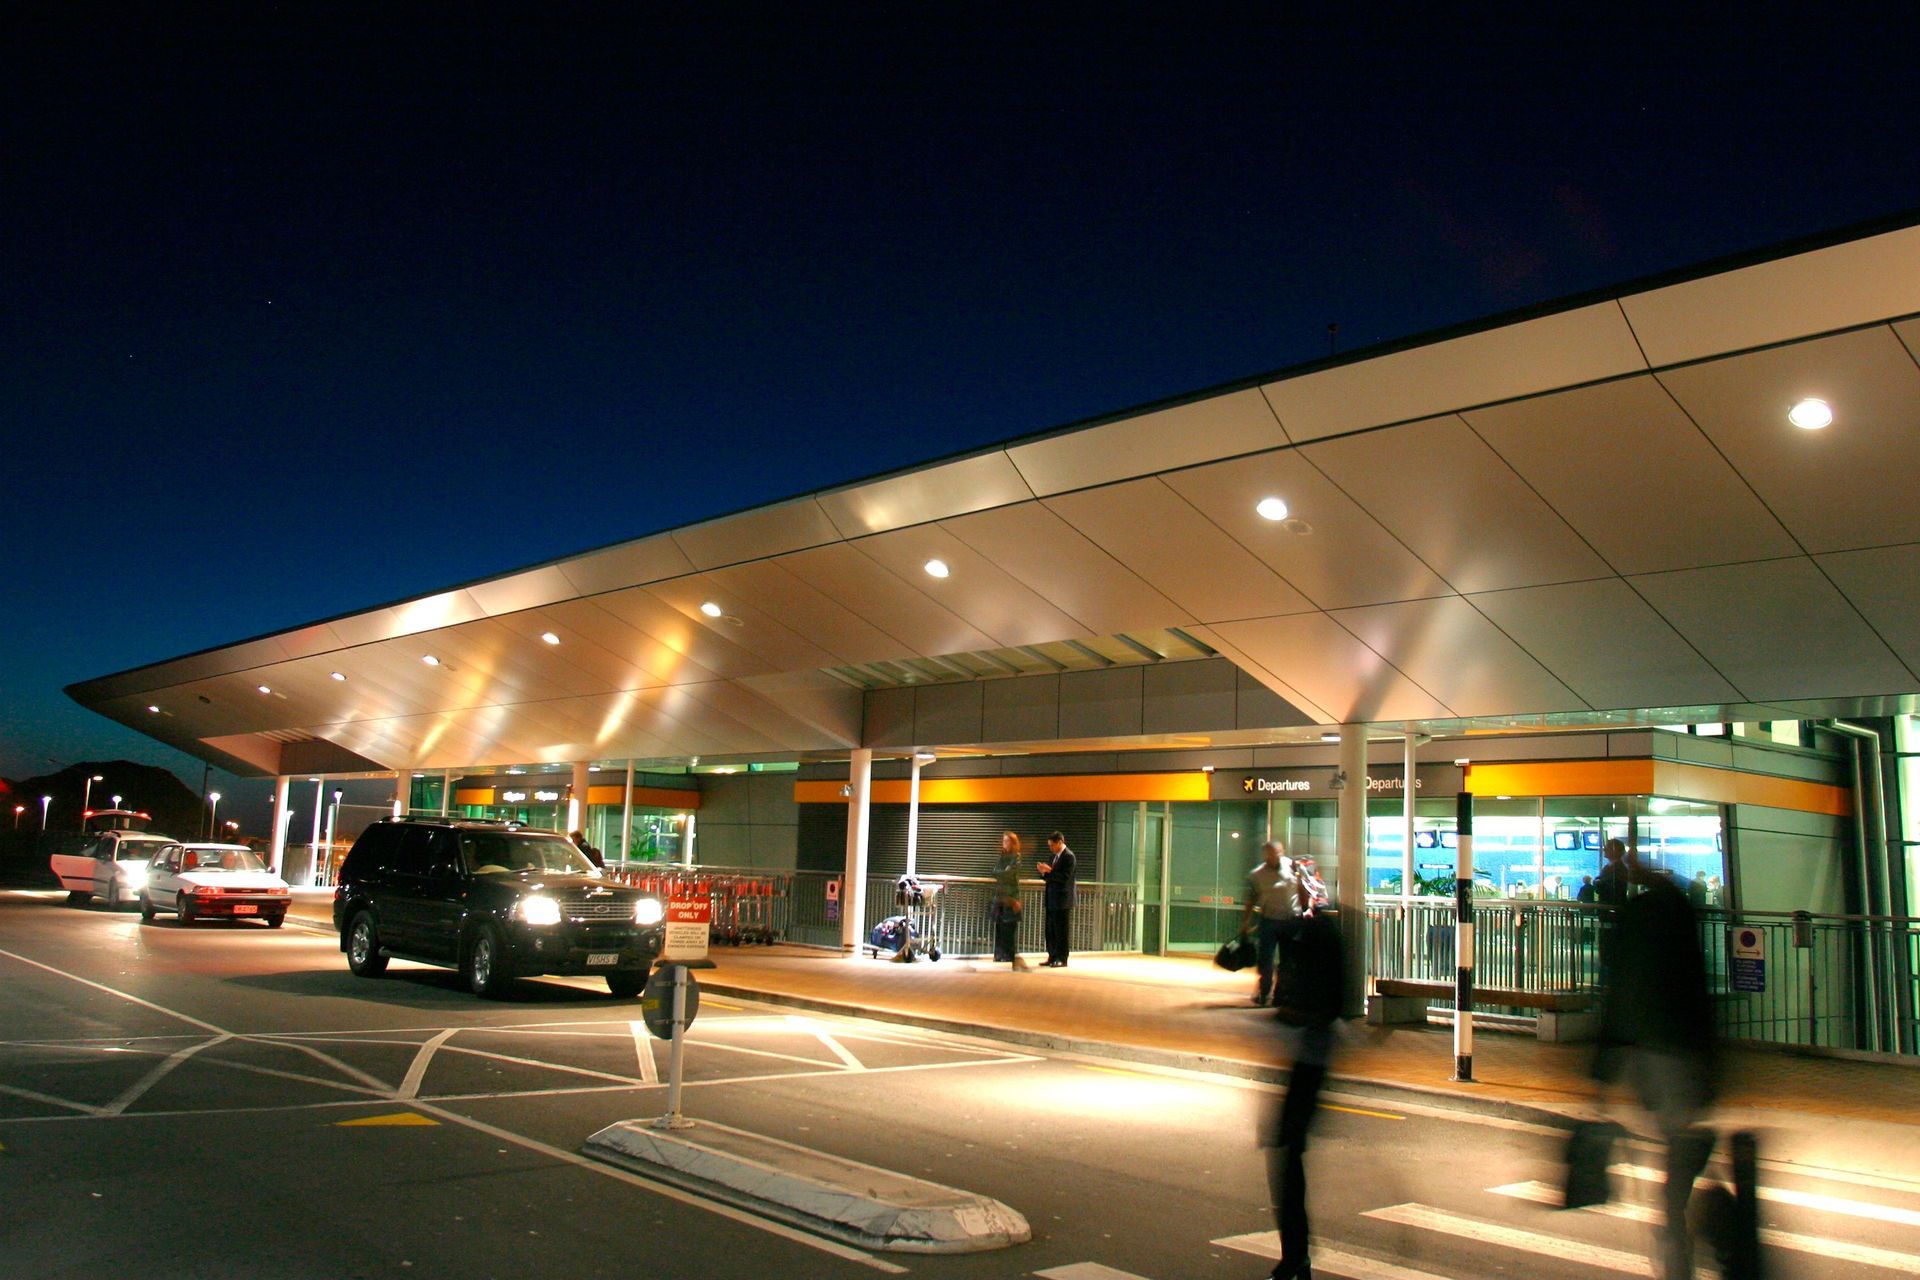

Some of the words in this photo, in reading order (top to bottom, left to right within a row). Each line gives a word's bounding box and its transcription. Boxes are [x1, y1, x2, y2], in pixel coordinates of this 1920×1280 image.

[1258, 779, 1310, 794] Departures
[1365, 776, 1422, 792] Departus
[678, 911, 699, 919] ONLY
